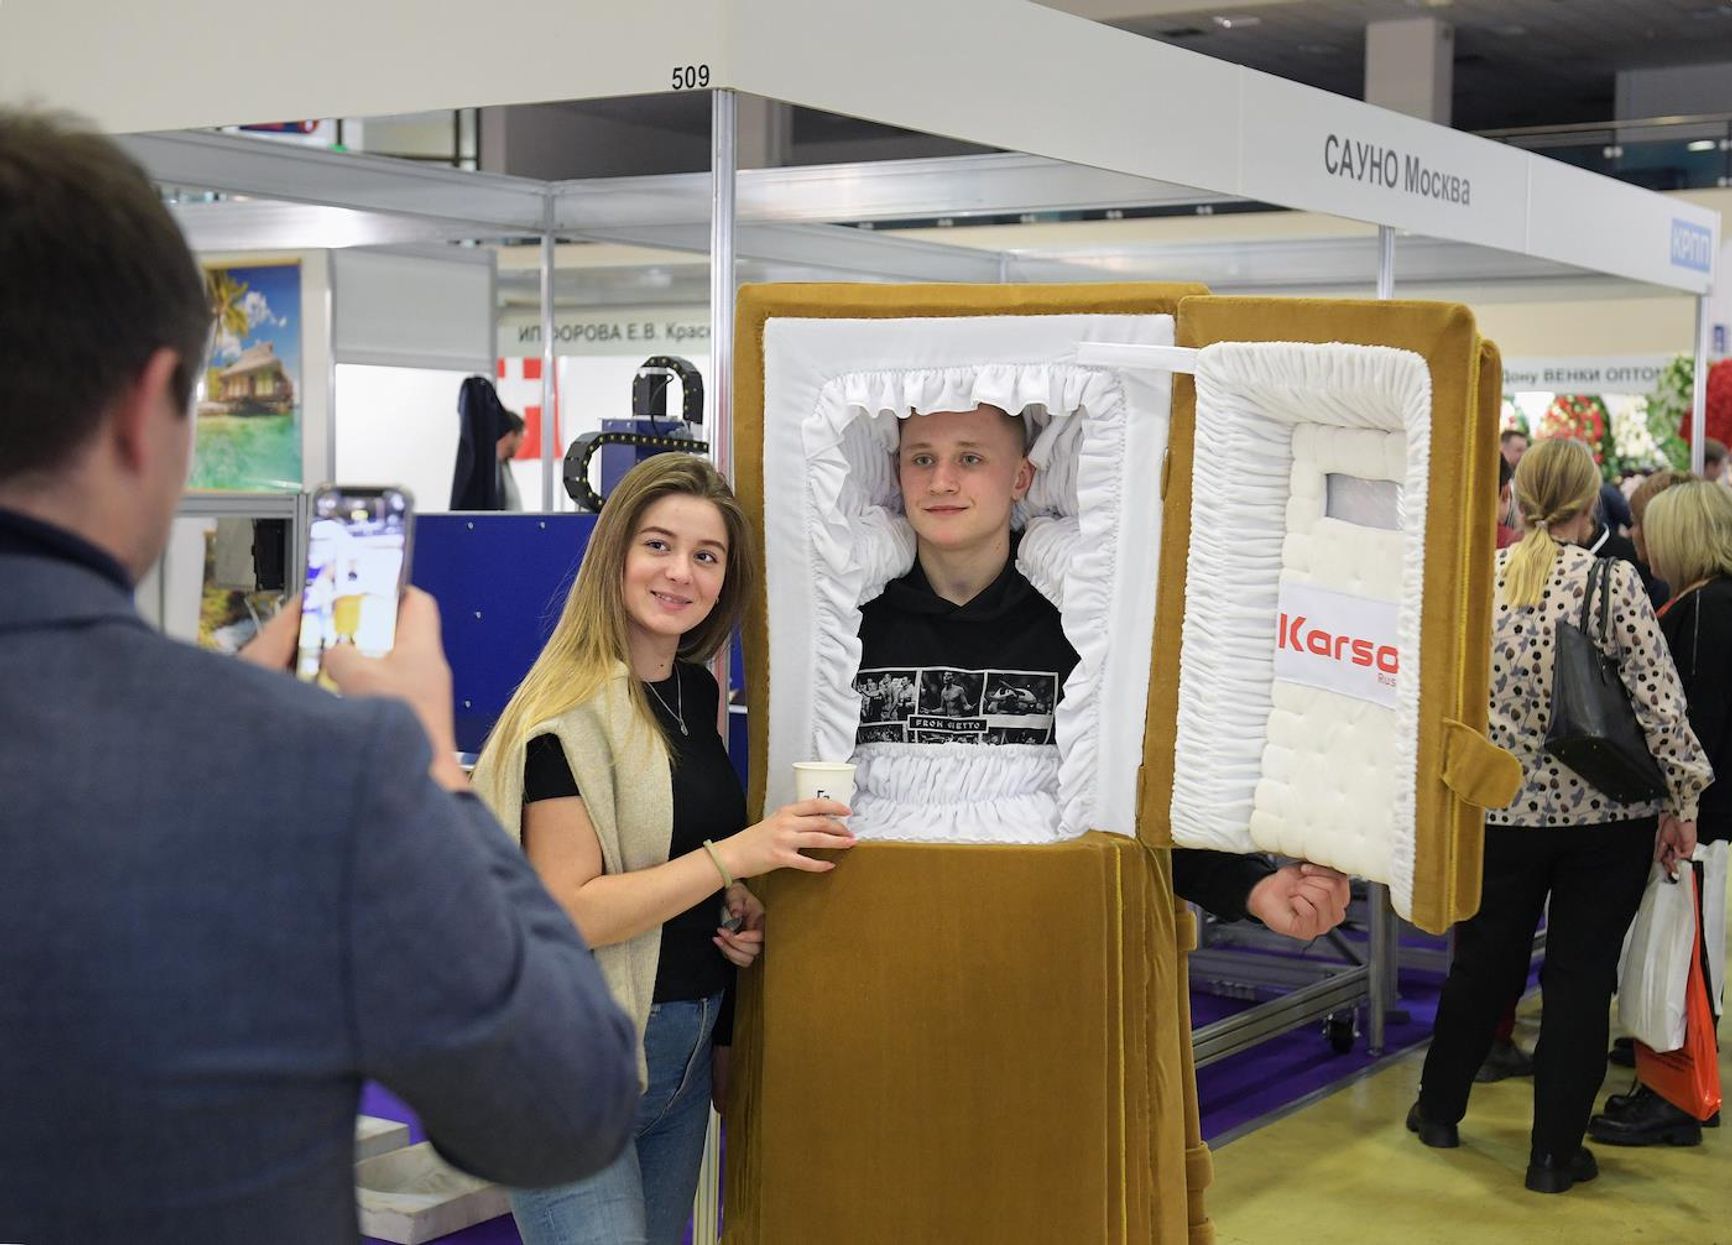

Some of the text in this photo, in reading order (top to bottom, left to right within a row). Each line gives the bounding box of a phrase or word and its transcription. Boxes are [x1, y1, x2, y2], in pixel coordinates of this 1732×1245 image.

[672, 65, 710, 89] 509
[1325, 134, 1471, 205] САУНО Москва
[518, 325, 541, 342] ИП
[1544, 367, 1600, 382] ВЕНКИ
